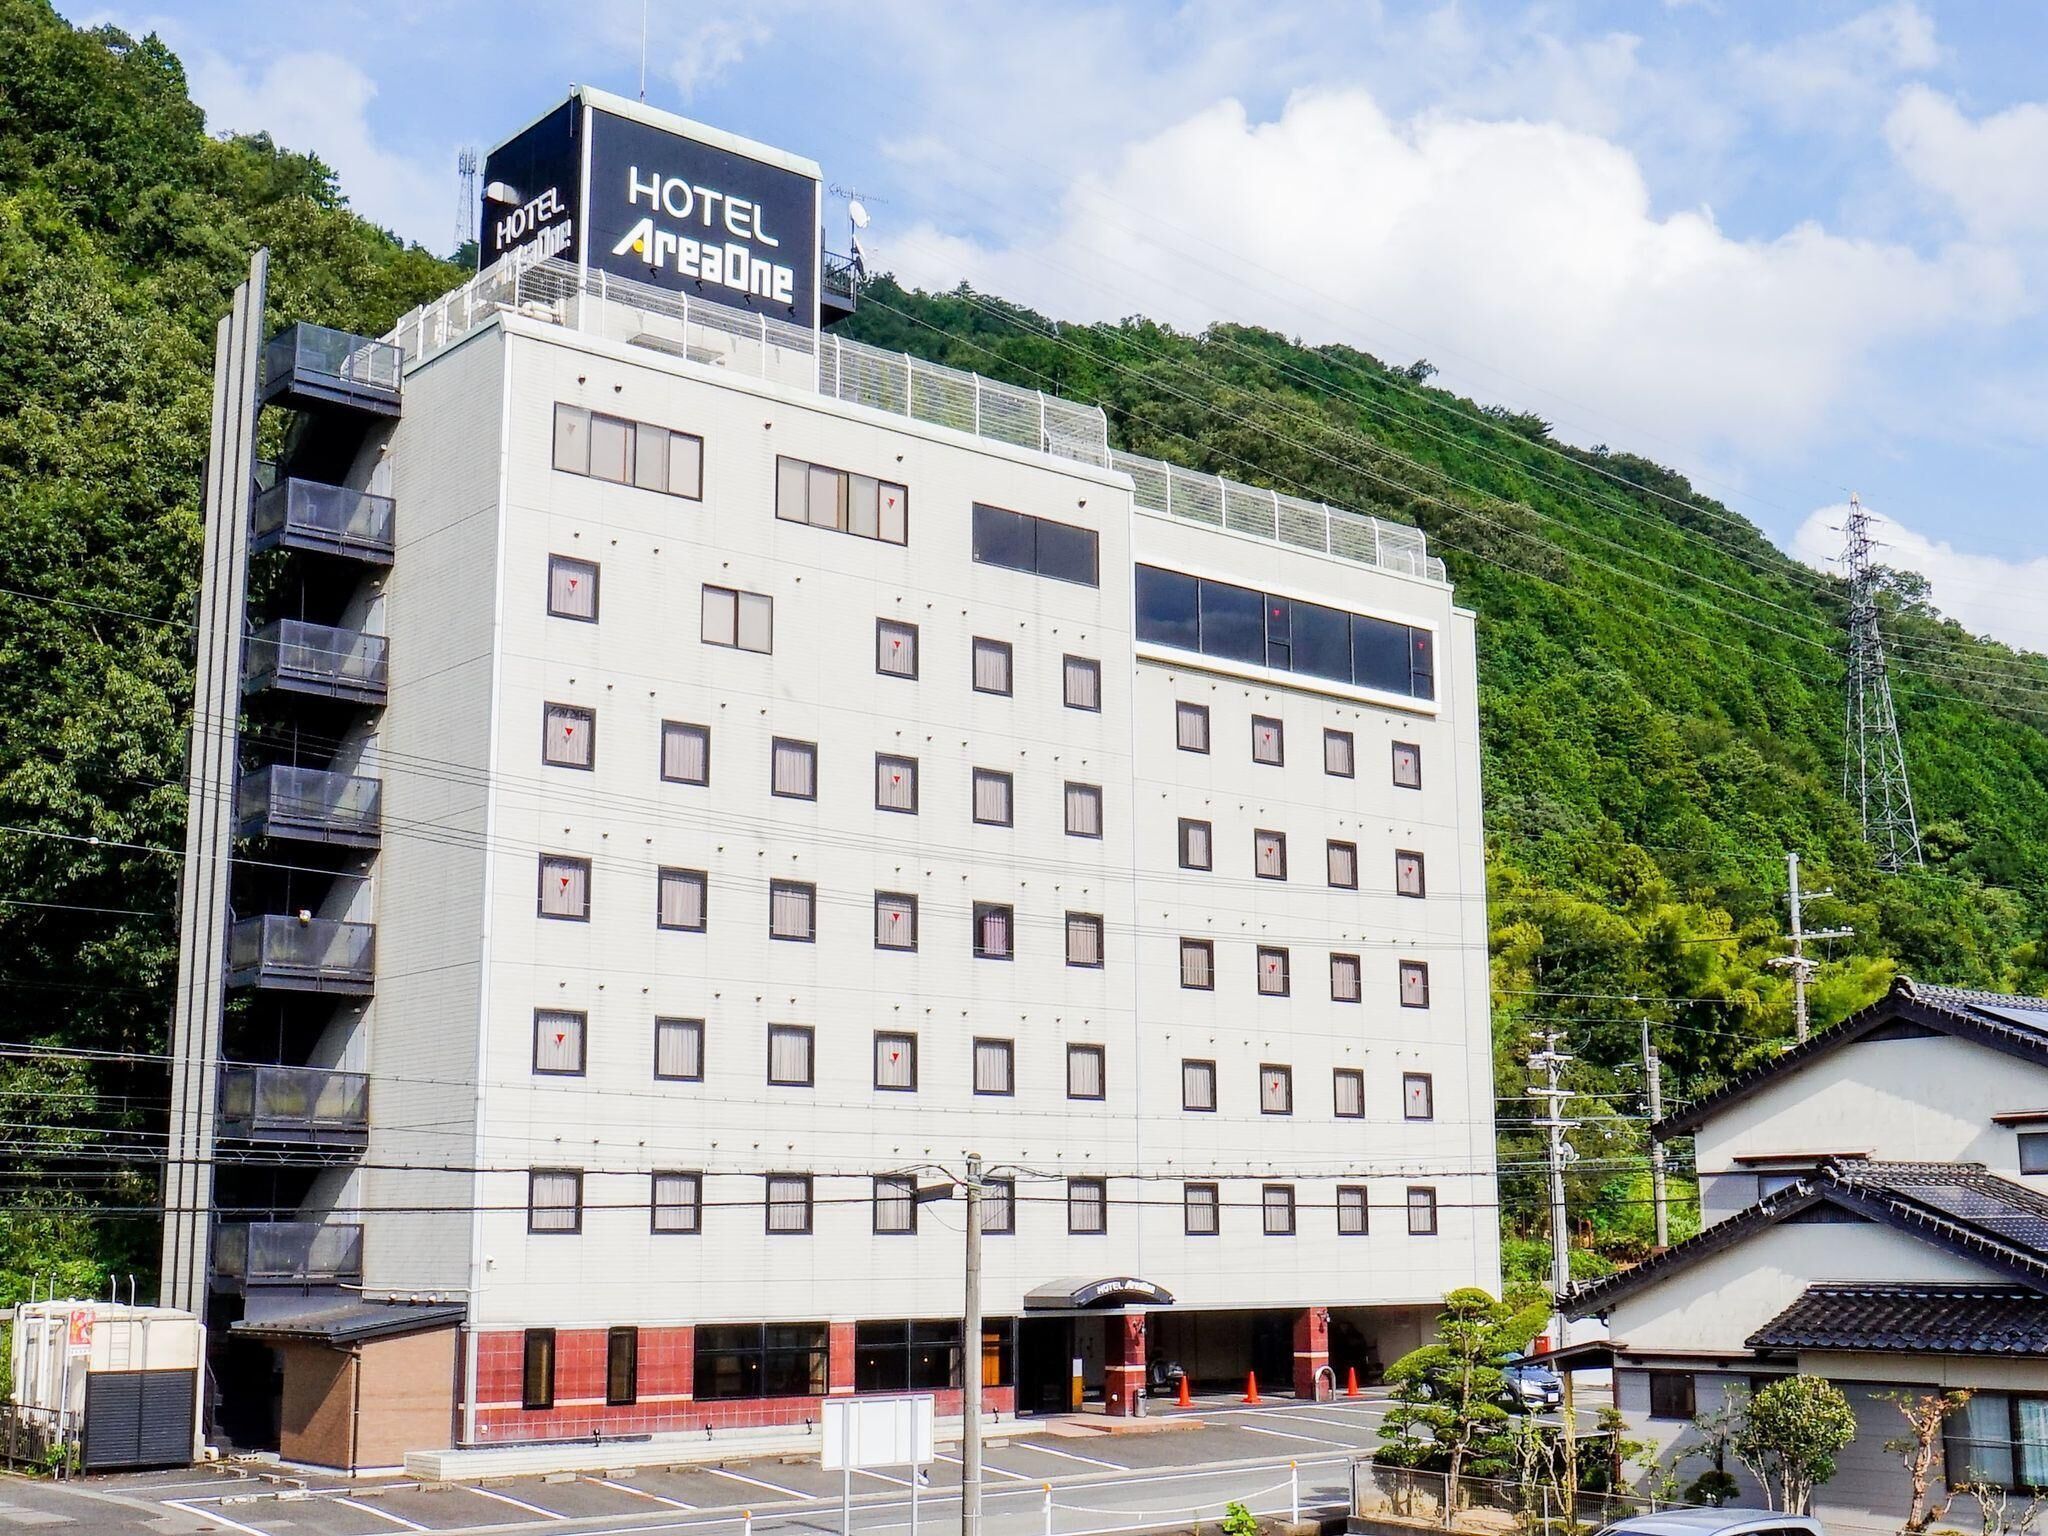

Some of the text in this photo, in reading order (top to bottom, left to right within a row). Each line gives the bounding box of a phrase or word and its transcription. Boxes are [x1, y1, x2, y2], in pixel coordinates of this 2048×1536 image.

[495, 186, 566, 250] HOTEL
[628, 165, 780, 248] HOTEL
[611, 217, 795, 305] AreaOne
[1096, 1281, 1124, 1295] HOTEL
